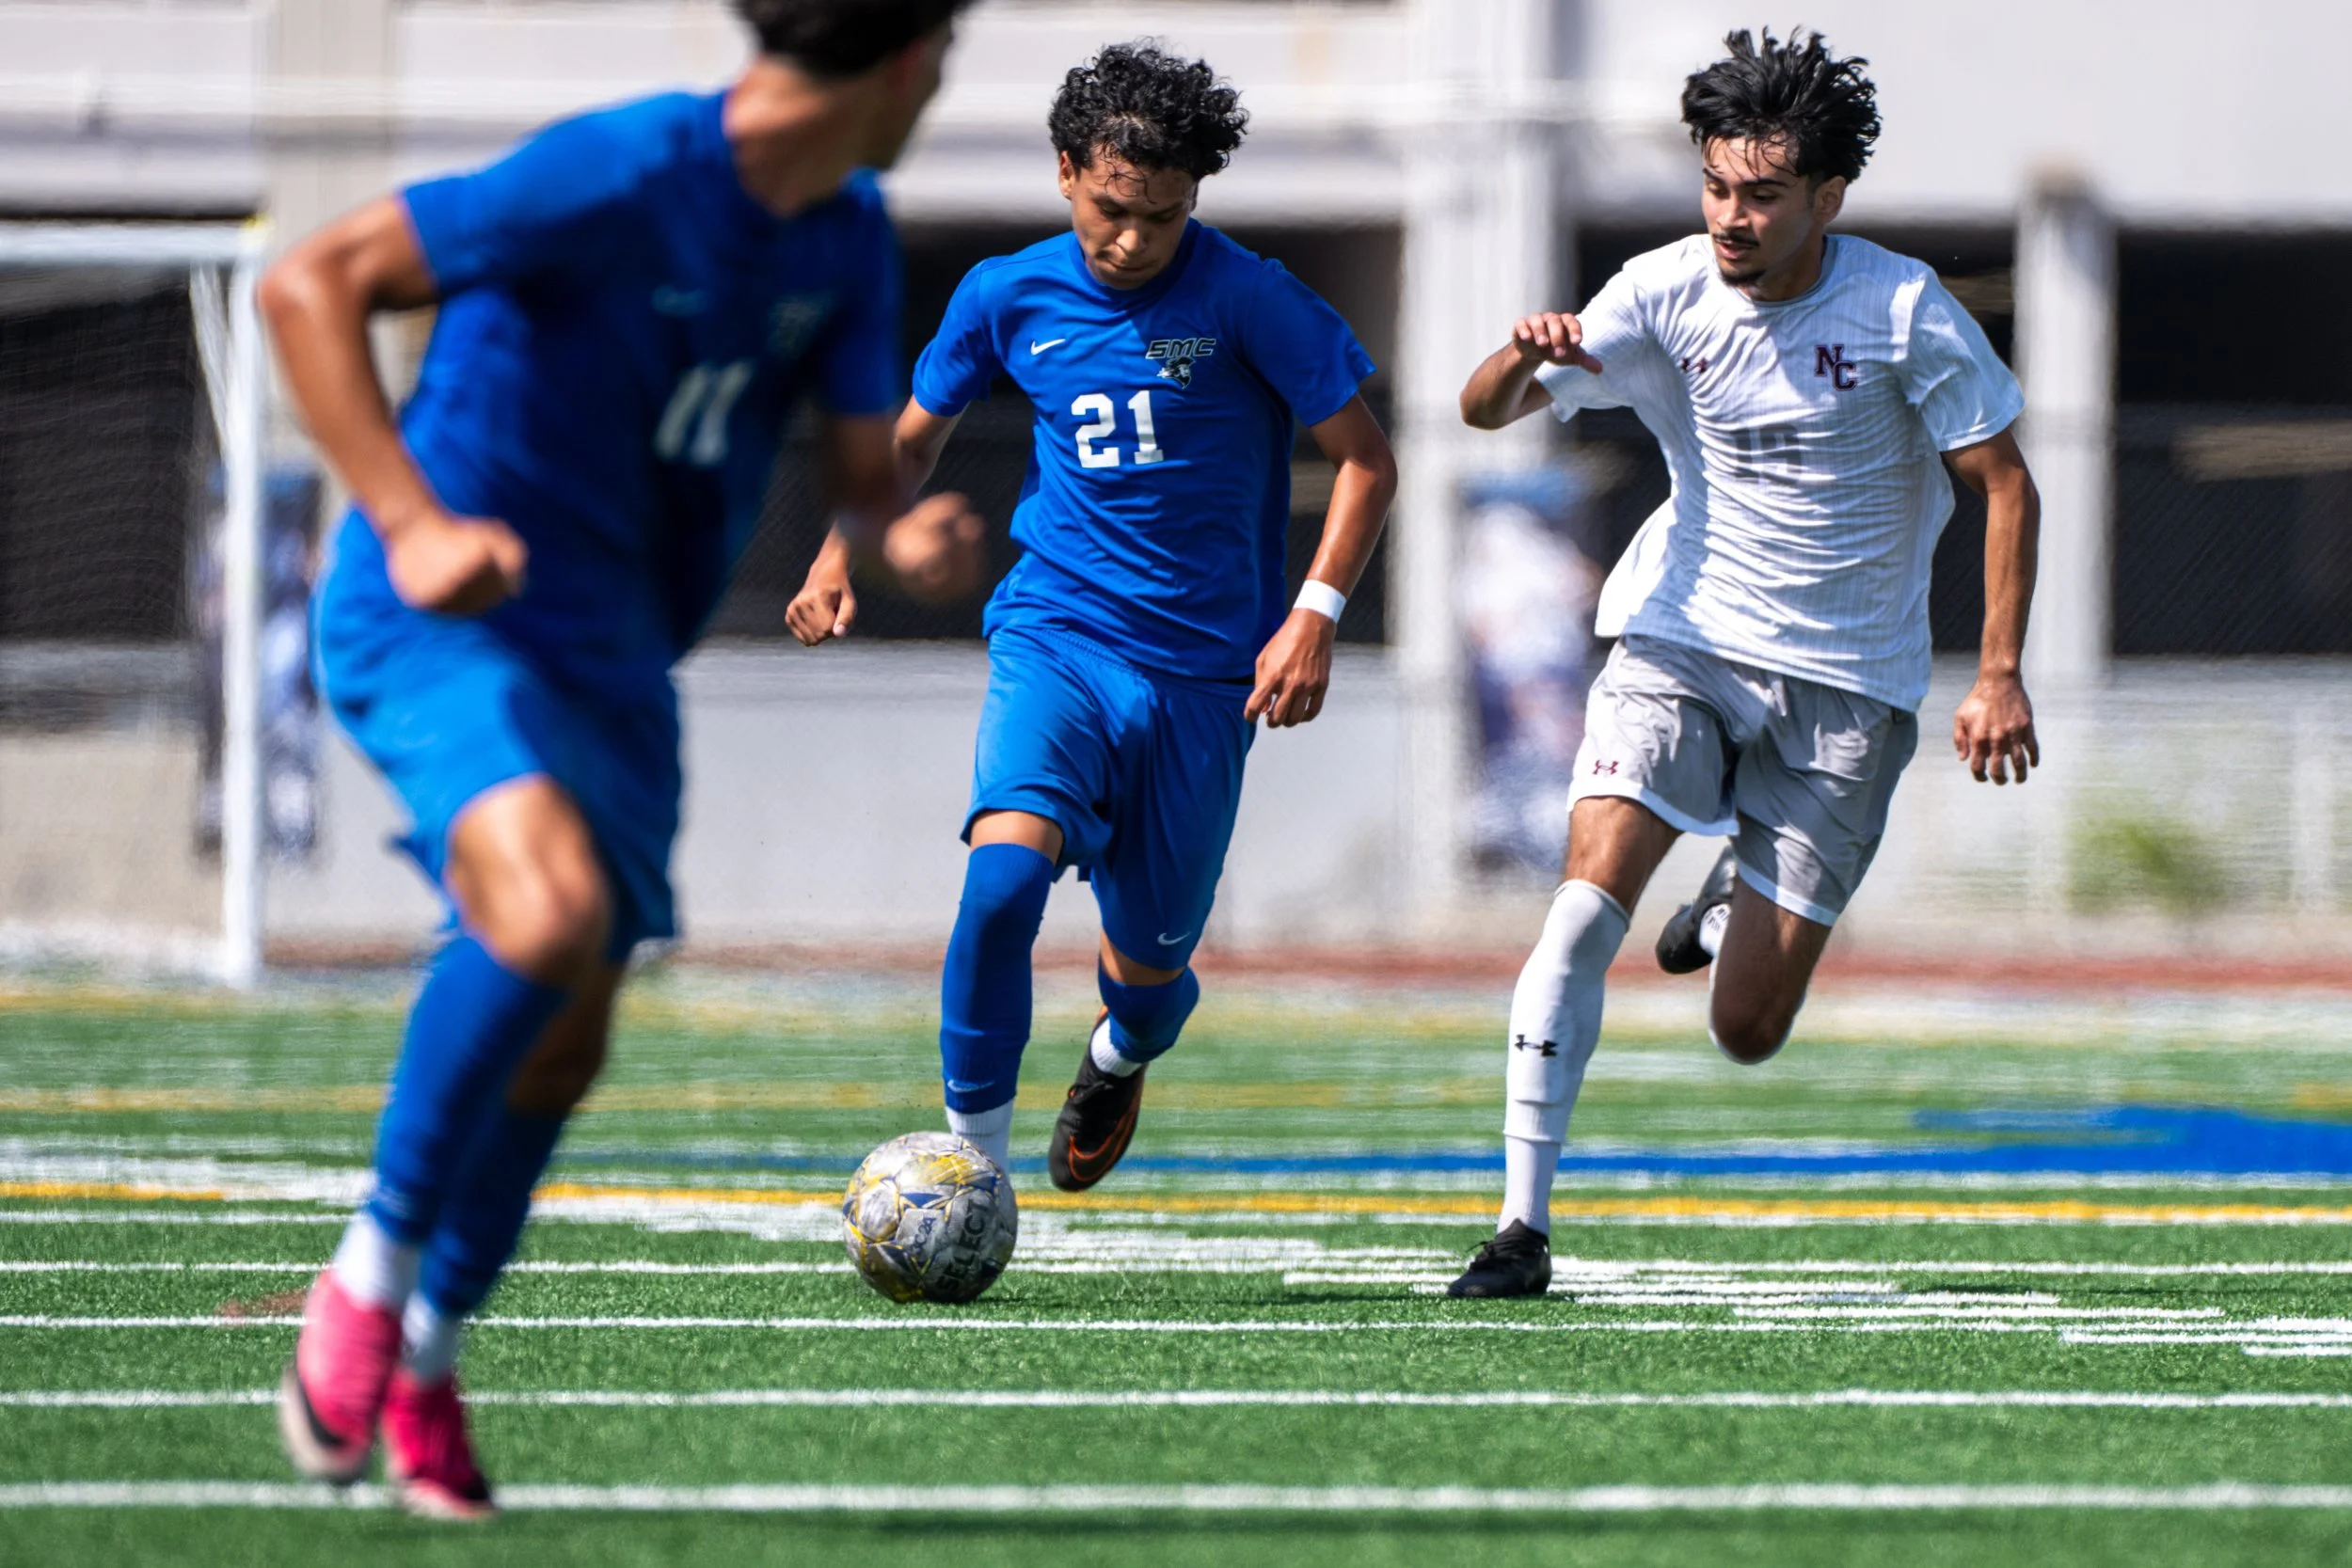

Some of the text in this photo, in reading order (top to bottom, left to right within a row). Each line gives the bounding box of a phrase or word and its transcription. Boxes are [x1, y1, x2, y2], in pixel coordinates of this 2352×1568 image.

[1145, 338, 1216, 359] SMC
[1814, 344, 1857, 391] NC
[655, 361, 752, 465] 11
[1071, 389, 1164, 468] 21
[936, 1198, 992, 1292] SELECT
